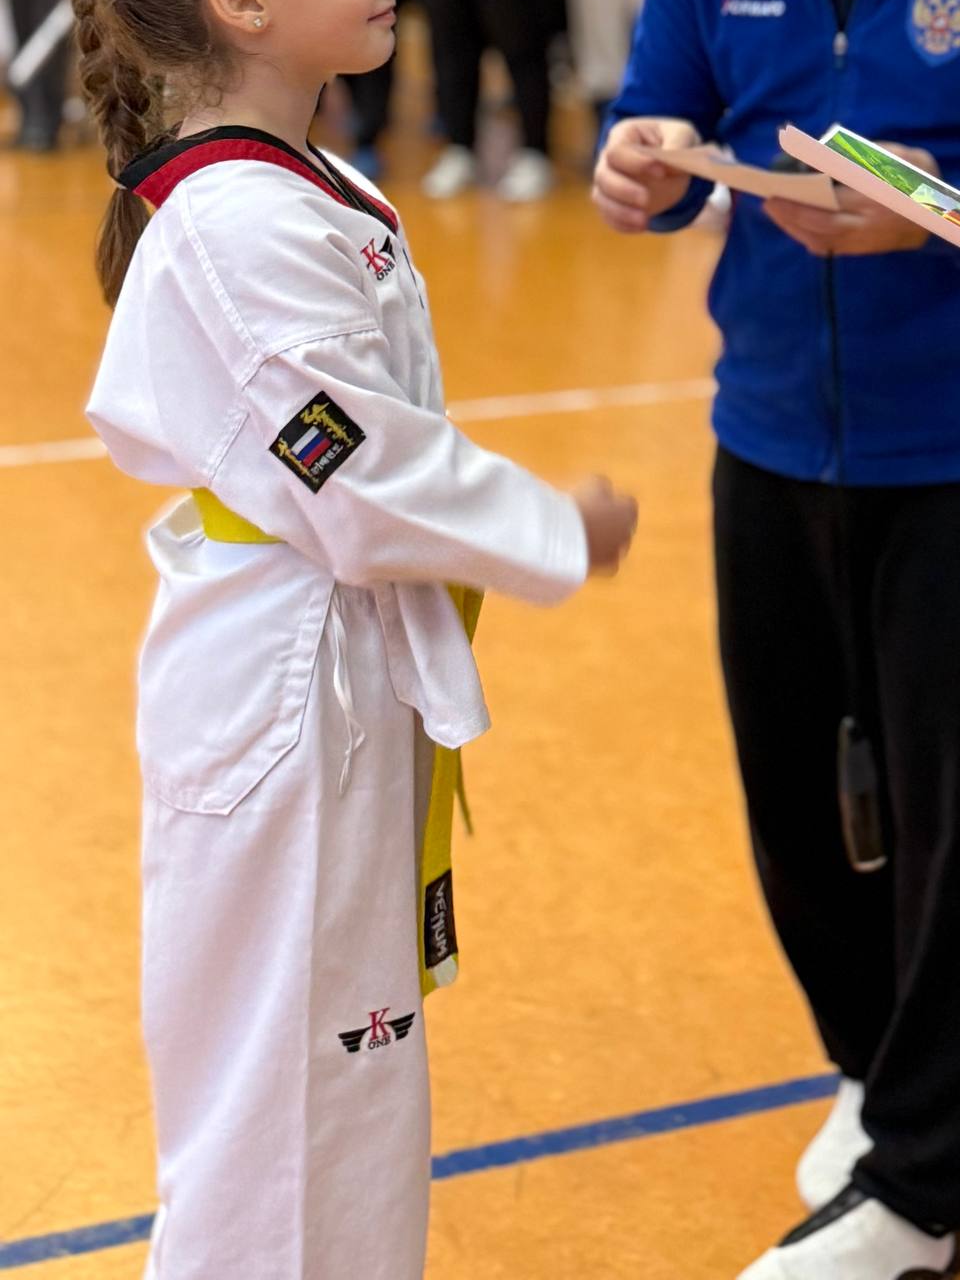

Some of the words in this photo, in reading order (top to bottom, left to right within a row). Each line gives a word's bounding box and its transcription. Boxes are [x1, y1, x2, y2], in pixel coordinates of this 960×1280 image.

[360, 237, 391, 274] K
[430, 880, 448, 958] VENUM
[368, 1006, 391, 1041] K
